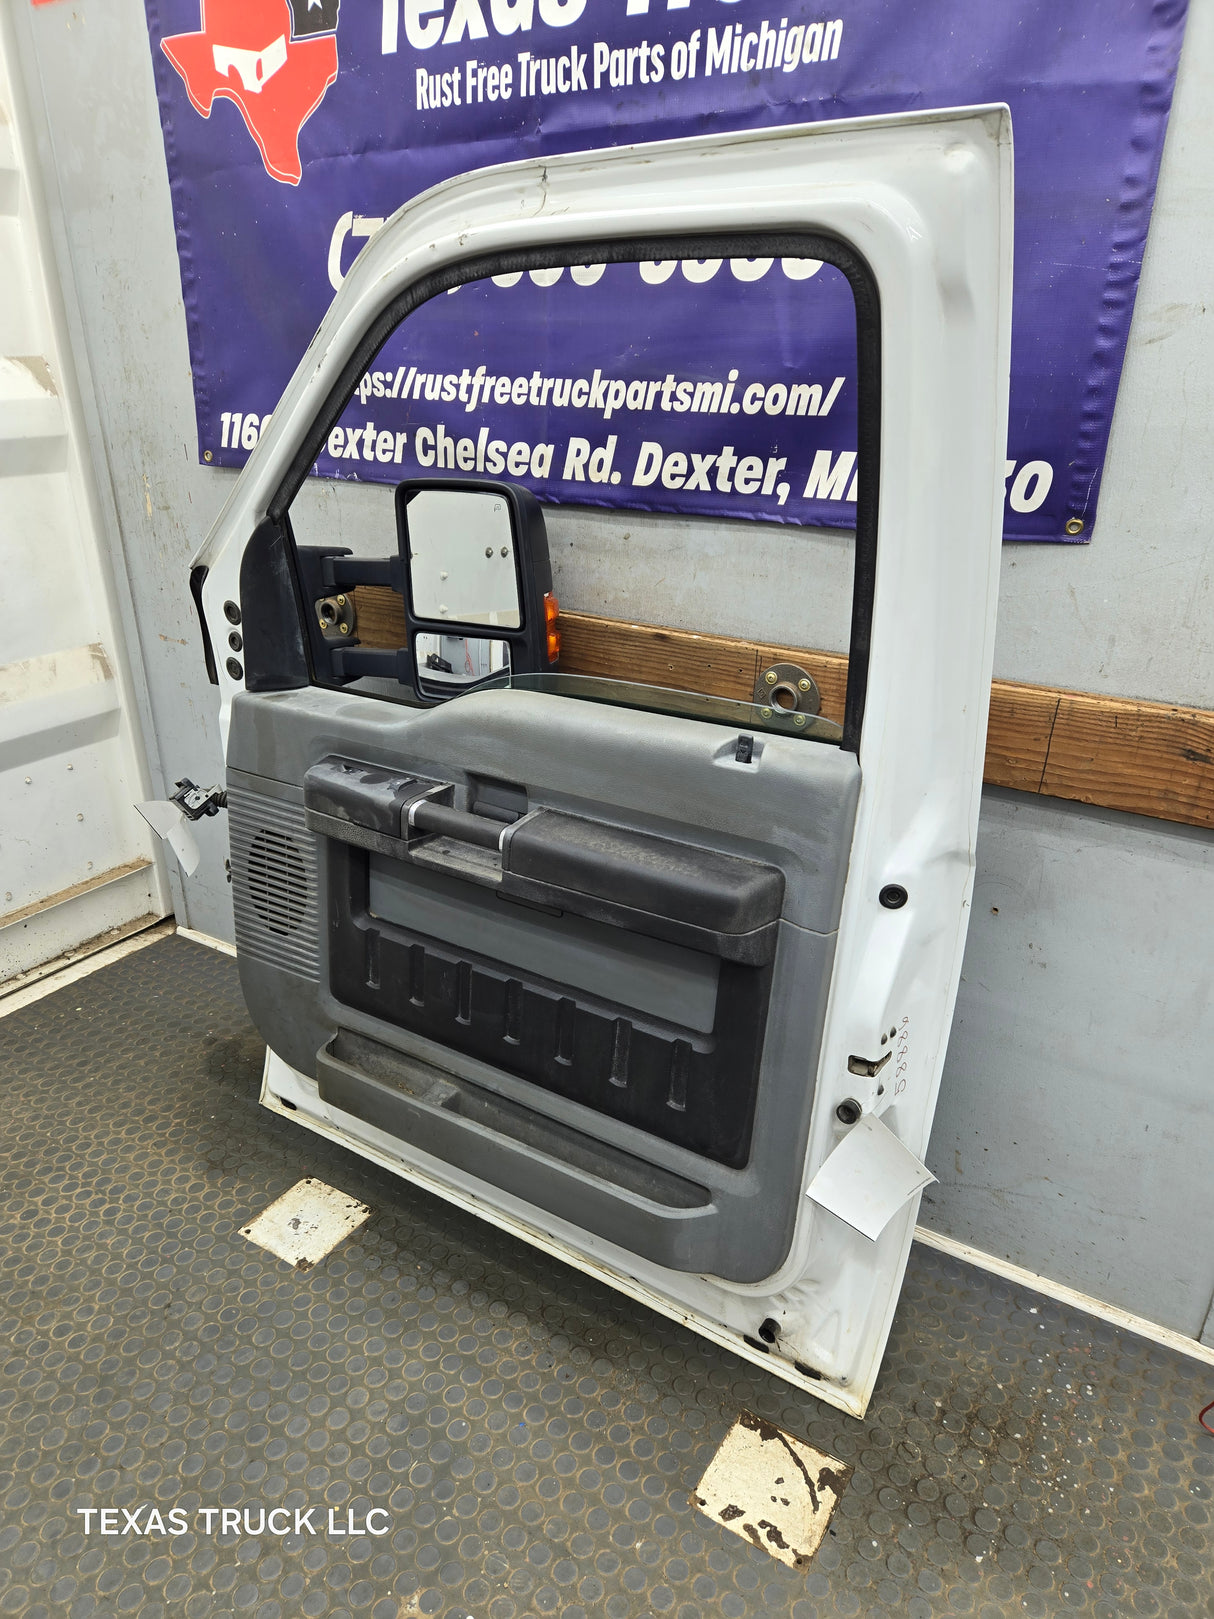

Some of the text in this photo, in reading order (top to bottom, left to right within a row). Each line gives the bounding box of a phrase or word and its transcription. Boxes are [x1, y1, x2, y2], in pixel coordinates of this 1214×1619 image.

[415, 17, 844, 110] Rust Free Truck Parts of Michigan
[354, 365, 846, 419] ps://rustfreetruckpartsmi.com/
[320, 421, 408, 464] exter
[415, 424, 555, 479] Chelsea
[562, 434, 622, 485] Rd.
[632, 441, 791, 505] Dexter,
